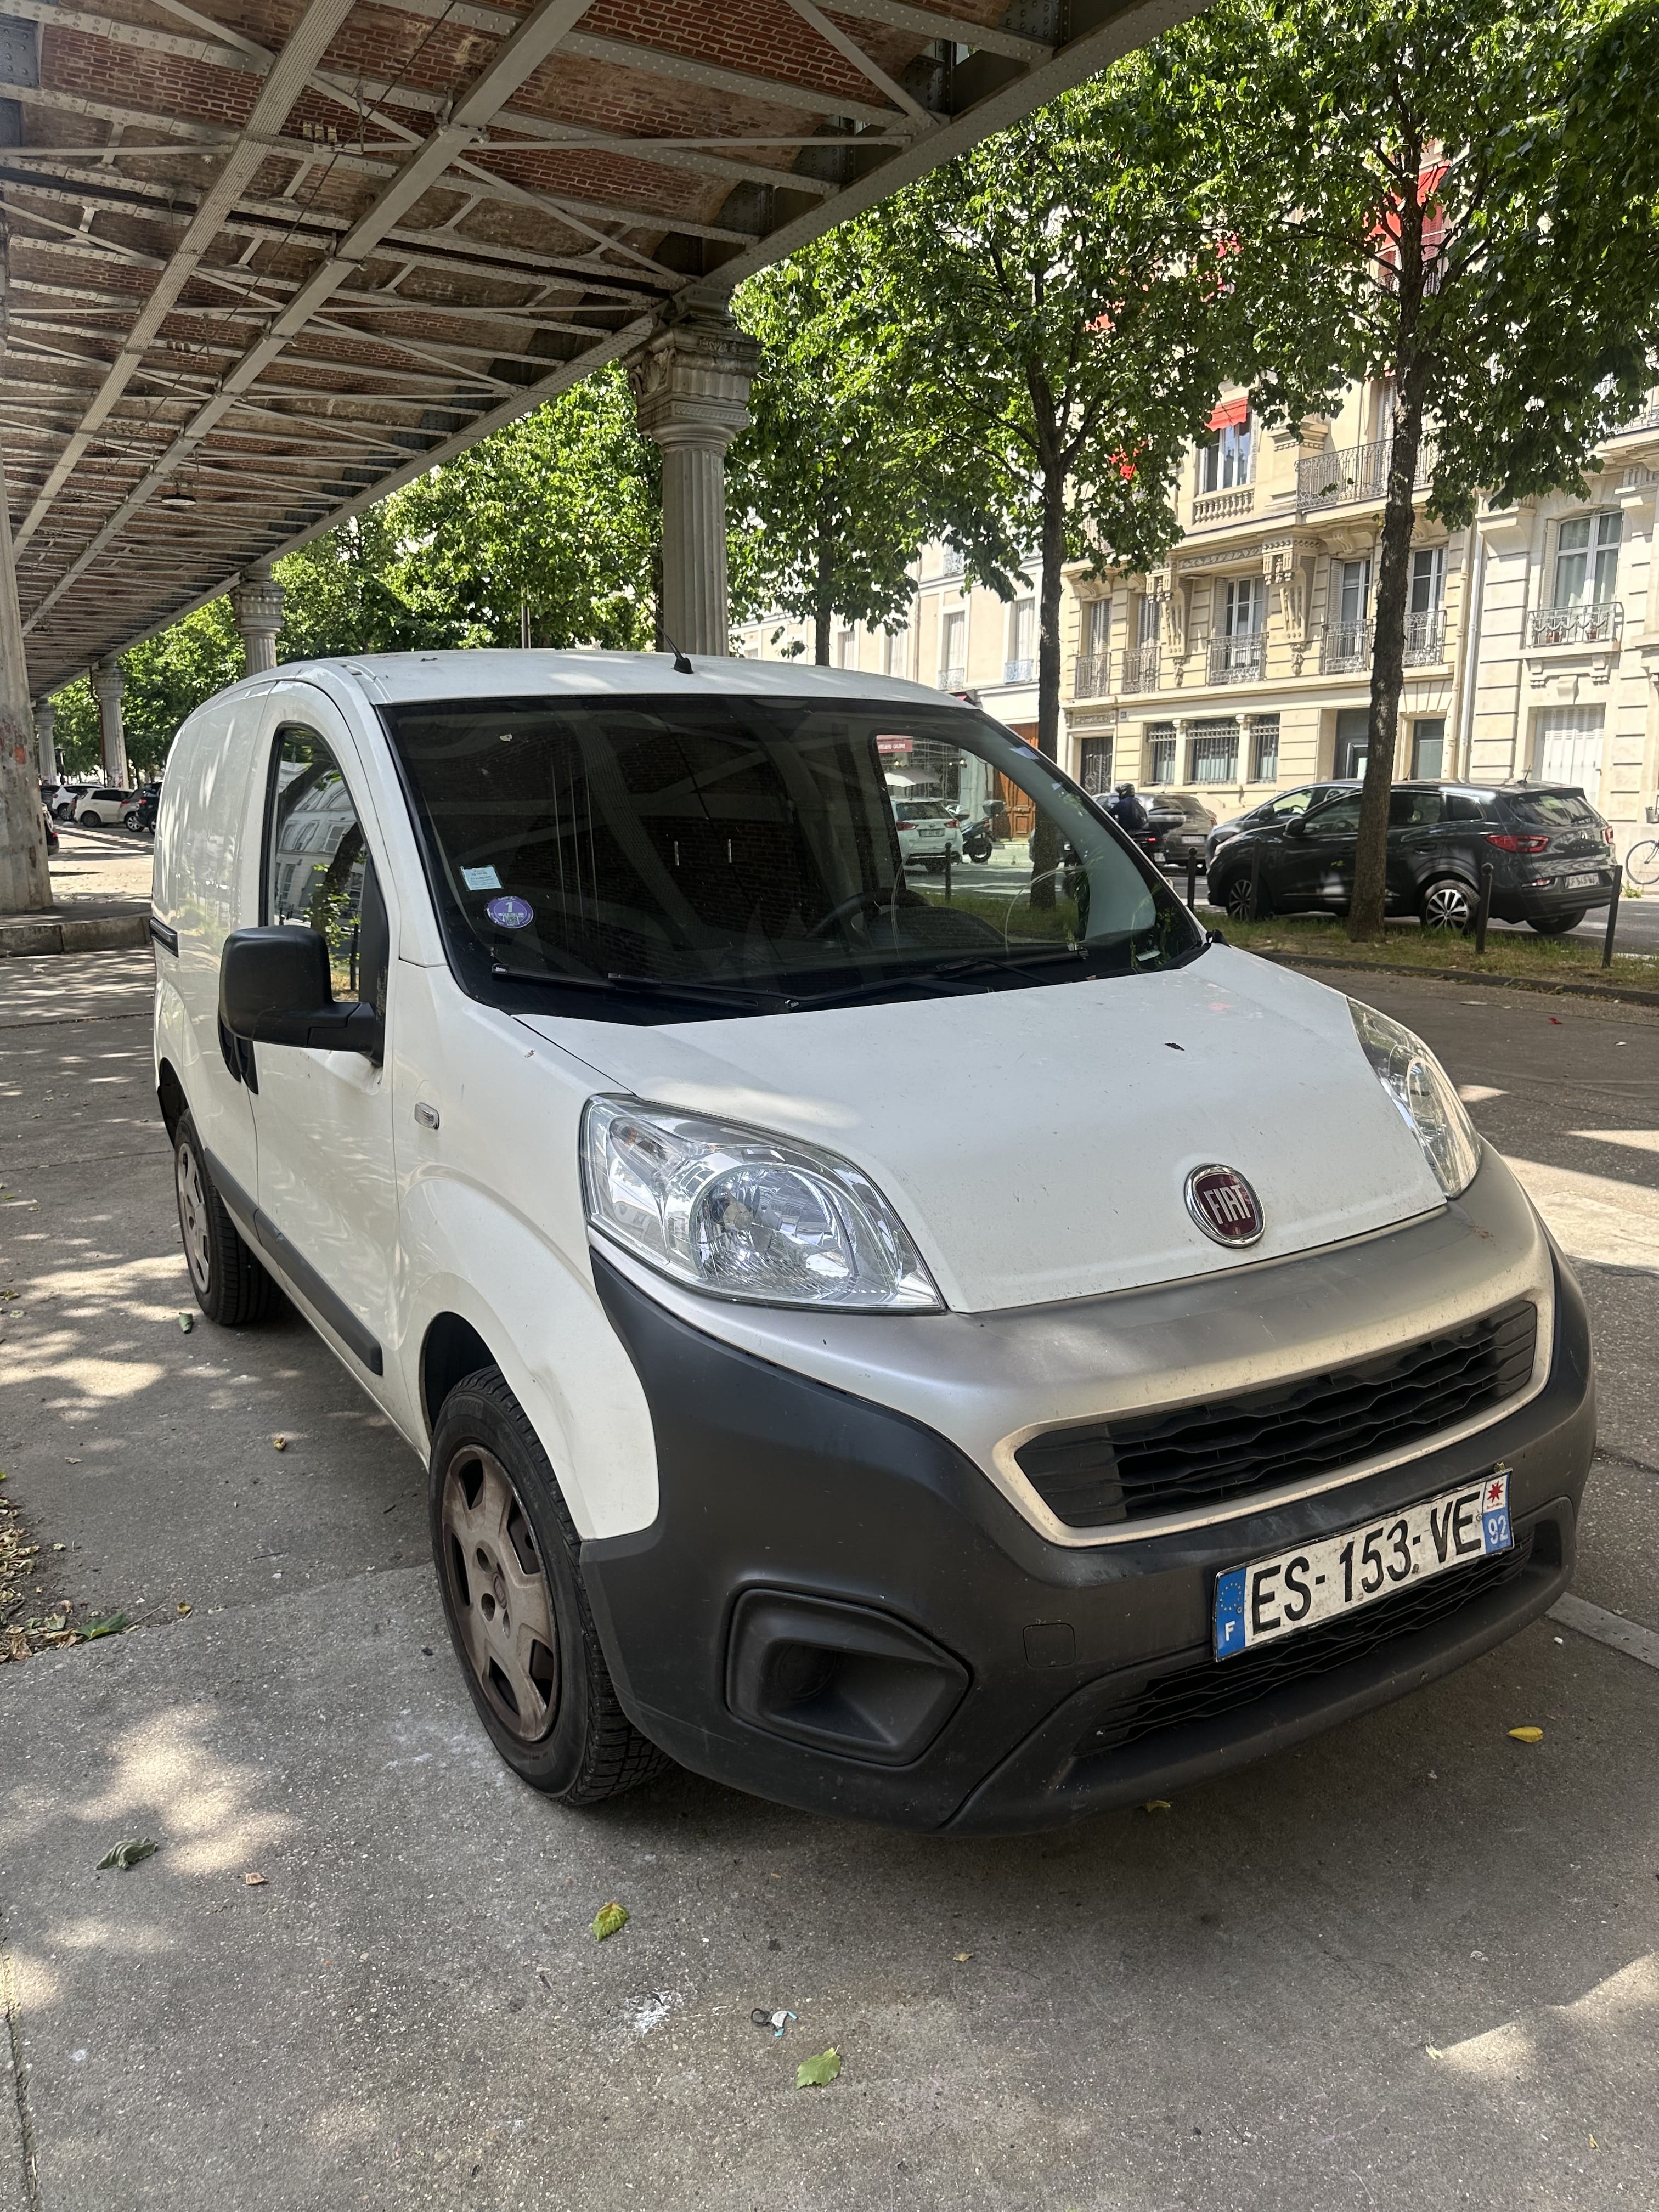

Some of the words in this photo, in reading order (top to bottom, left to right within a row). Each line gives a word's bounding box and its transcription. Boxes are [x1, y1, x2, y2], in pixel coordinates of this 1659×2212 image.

[505, 901, 513, 913] 1
[1203, 1184, 1251, 1224] FIAT
[1487, 1515, 1509, 1545] 92
[1251, 1491, 1481, 1635] ES-153-VE
[1224, 1620, 1235, 1641] F
